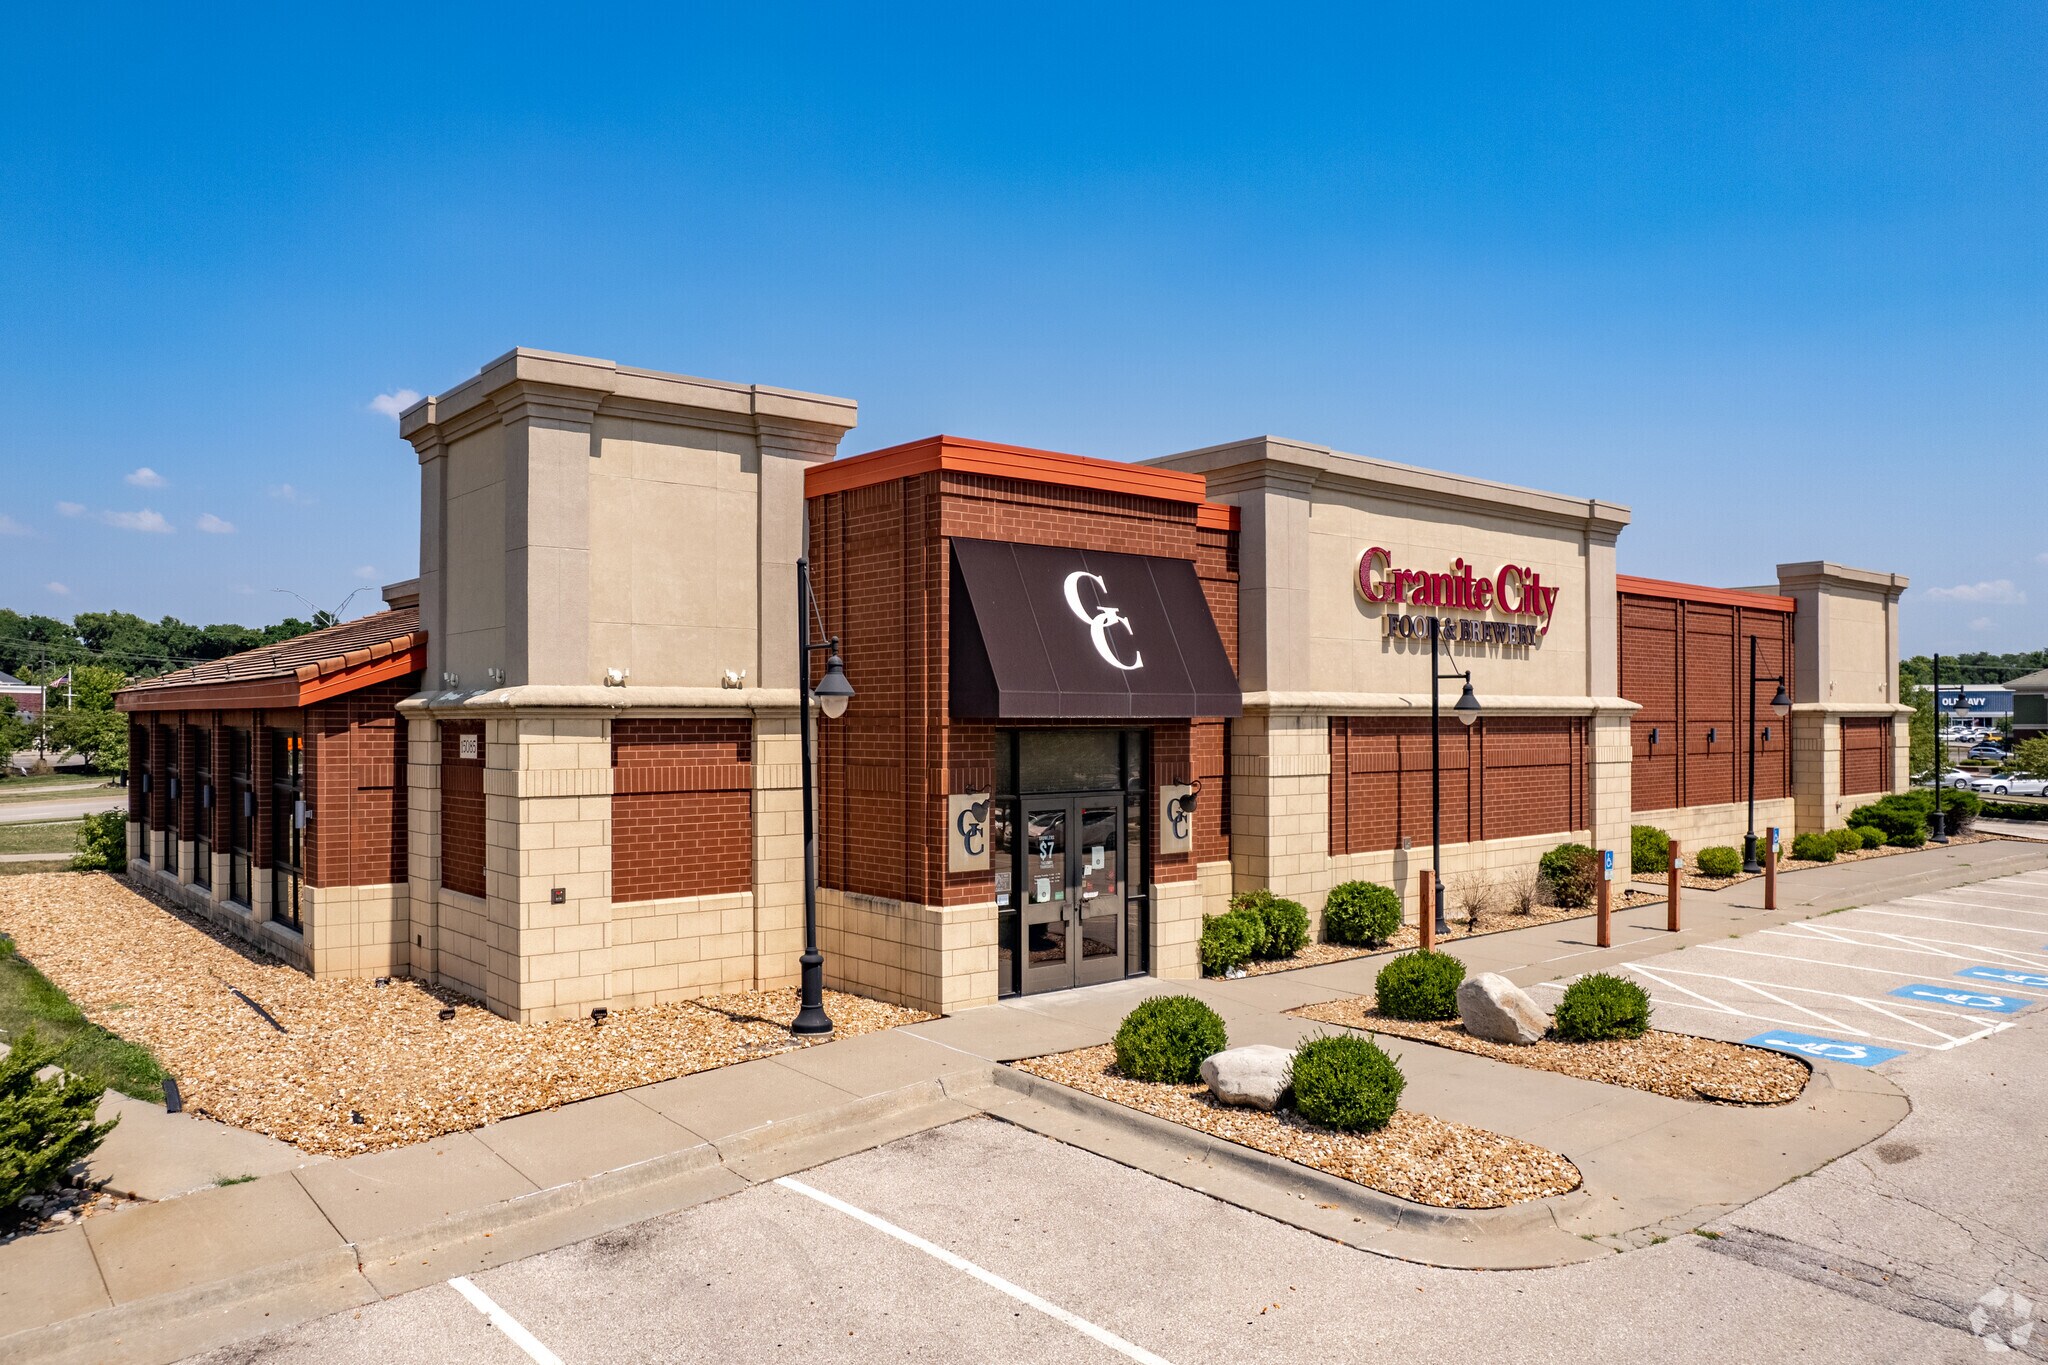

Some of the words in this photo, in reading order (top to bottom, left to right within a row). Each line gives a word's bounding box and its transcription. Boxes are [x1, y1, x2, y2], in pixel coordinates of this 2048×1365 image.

[1355, 547, 1494, 612] Granite
[1495, 564, 1560, 637] City
[1441, 616, 1457, 641] &
[1458, 618, 1538, 646] BREWERY
[1964, 698, 1986, 706] AVY
[1040, 840, 1055, 861] $7
